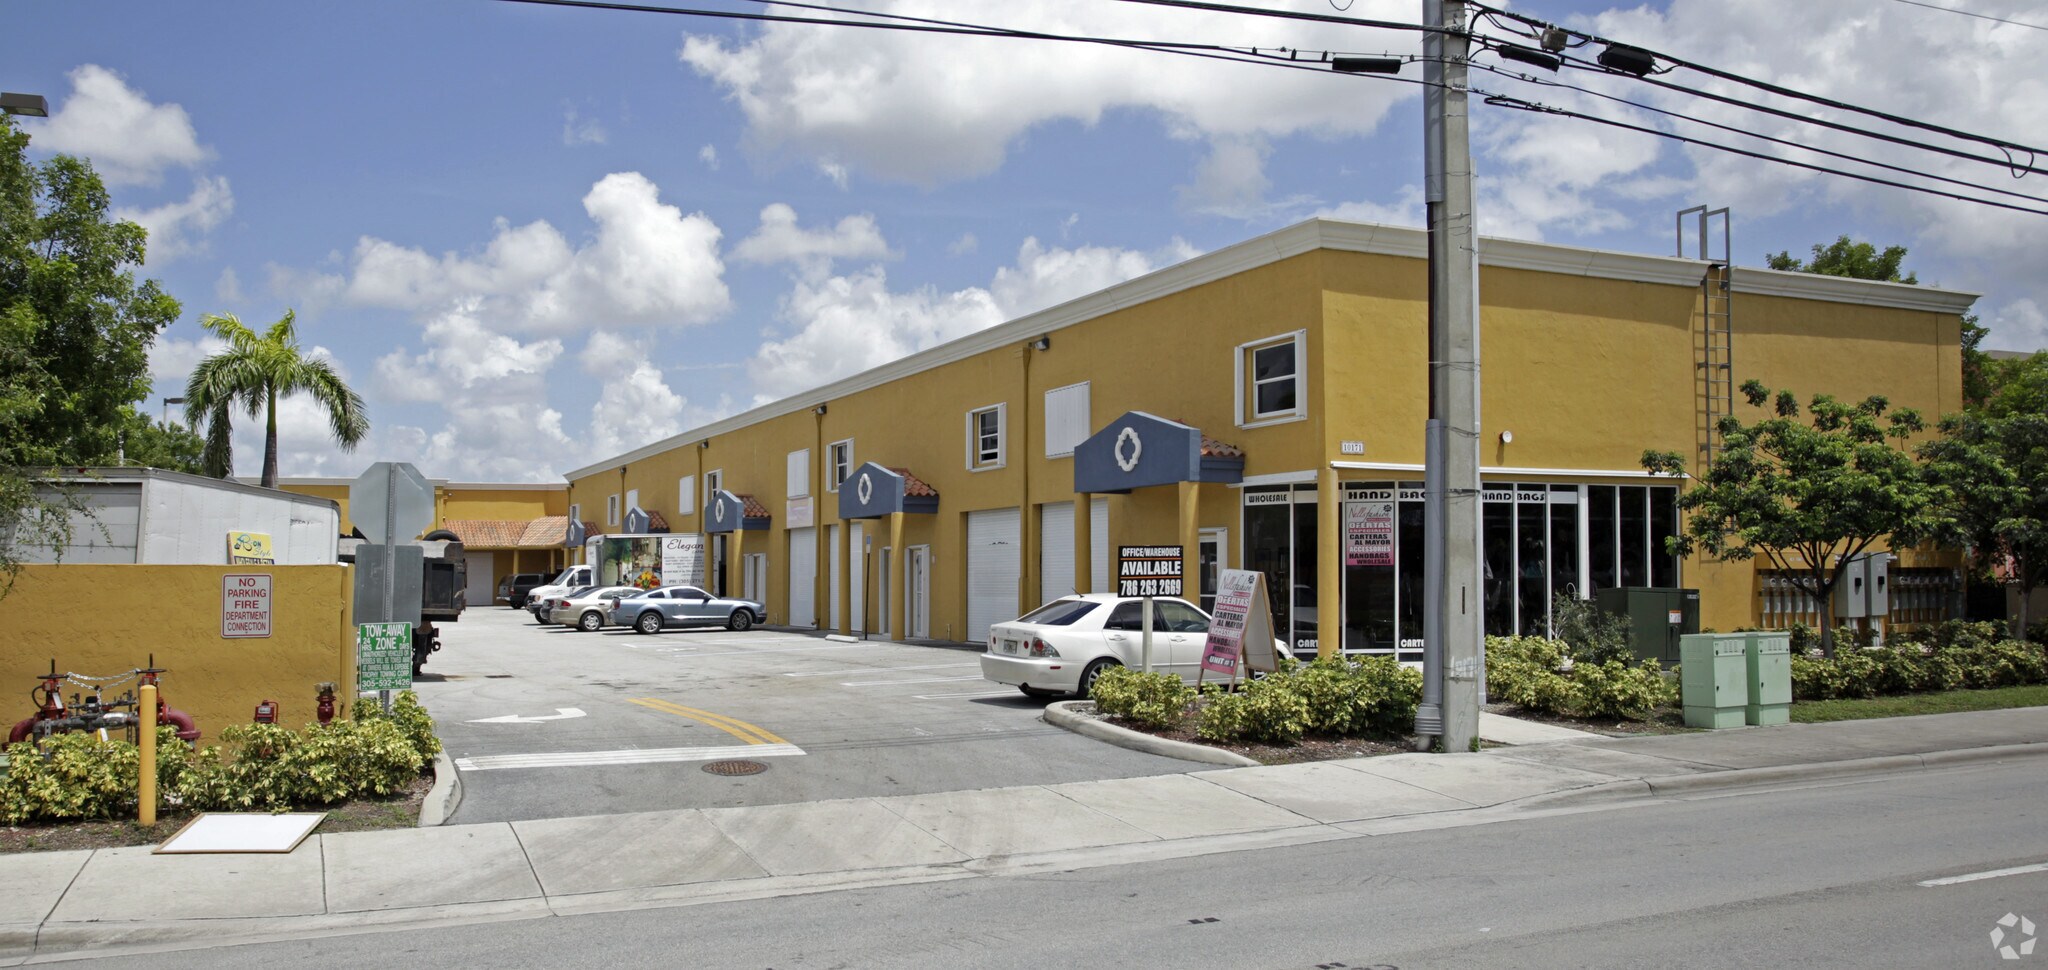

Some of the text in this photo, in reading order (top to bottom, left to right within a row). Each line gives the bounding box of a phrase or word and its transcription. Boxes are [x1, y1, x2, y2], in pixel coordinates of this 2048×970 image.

[1248, 494, 1287, 503] WHOLESALE
[1348, 491, 1425, 500] HAND BA
[667, 539, 704, 551] Elegan
[1122, 548, 1180, 557] OFFICE/WAREHOUSE
[1121, 561, 1181, 575] AVAILABLE
[239, 578, 256, 587] NO
[1120, 579, 1181, 596] 786 263 2669
[228, 589, 266, 598] PARKING
[235, 600, 259, 609] FIRE
[1216, 595, 1250, 606] OFERTAS
[226, 612, 267, 620] DEPARTMENT
[1215, 611, 1243, 621] CARTERAS
[227, 622, 266, 631] CONNECTION
[365, 624, 406, 637] TOW-AWAY
[376, 637, 396, 650] ZONE
[1298, 639, 1318, 648] CART
[1401, 639, 1424, 648] CART
[1209, 656, 1224, 664] UNIT
[362, 679, 410, 687] 305-592-1426
